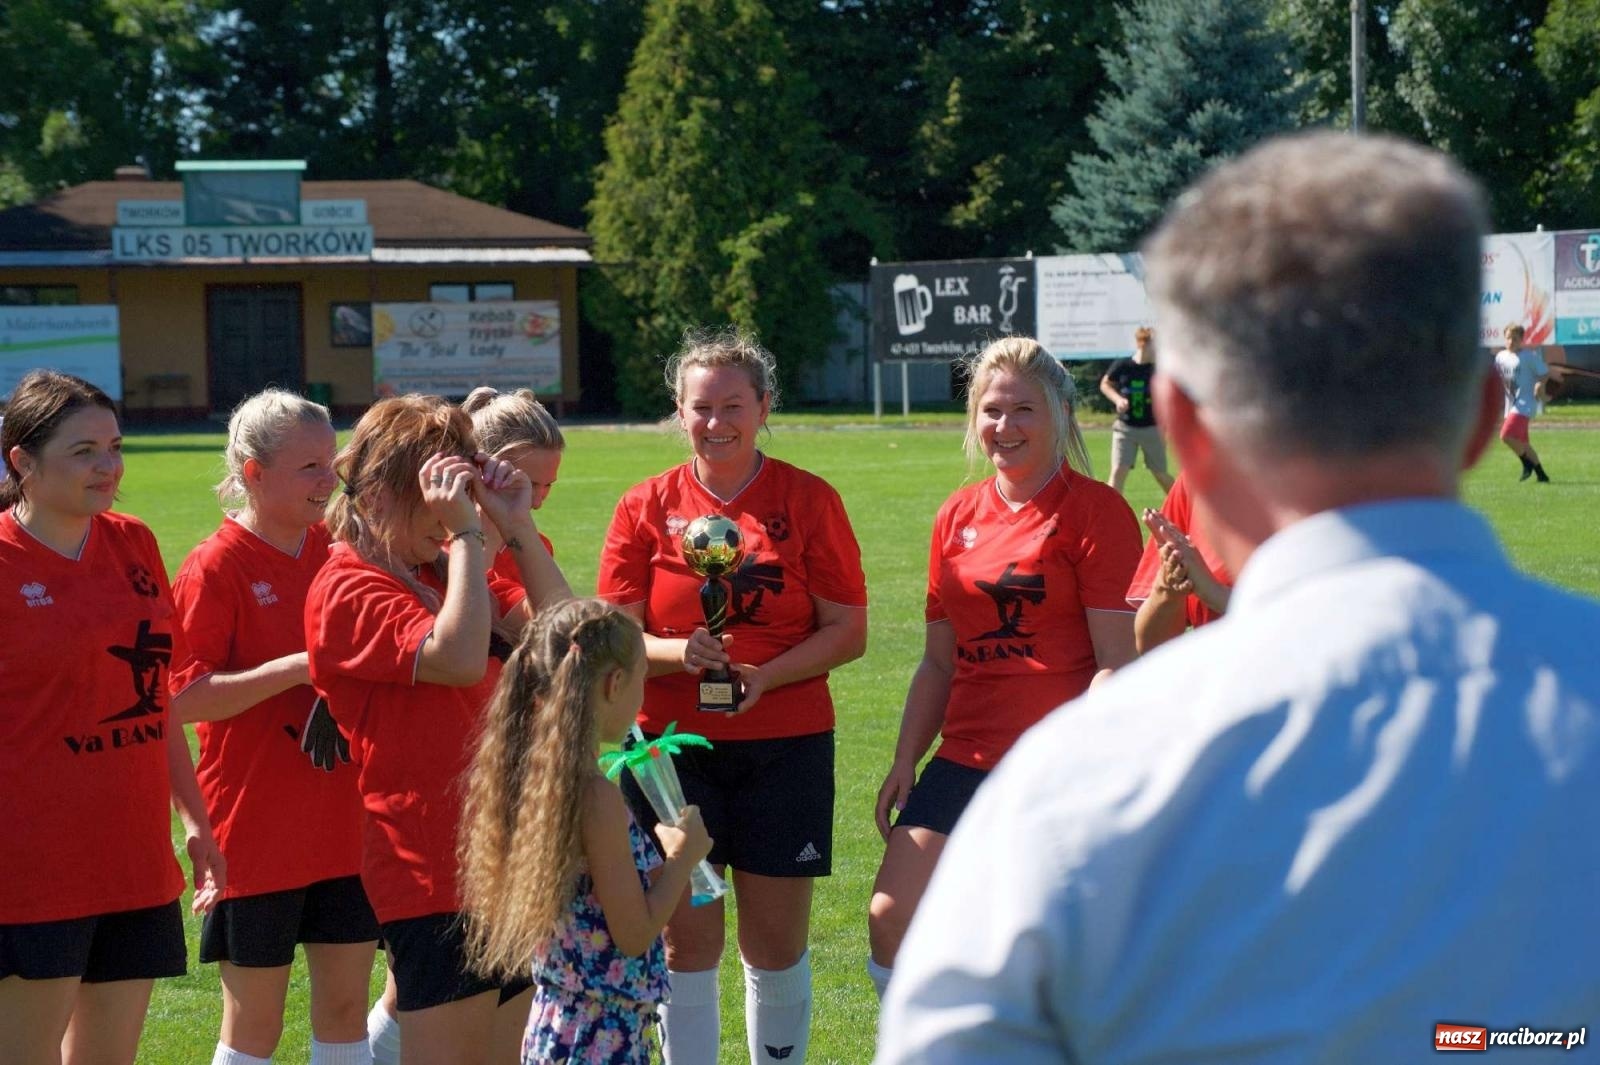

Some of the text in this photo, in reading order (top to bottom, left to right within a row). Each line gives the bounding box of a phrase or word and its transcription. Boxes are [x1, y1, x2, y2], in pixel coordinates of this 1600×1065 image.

[119, 226, 367, 256] LKS 05 TWORKÓW
[935, 276, 969, 297] LEX
[954, 304, 992, 325] BAR
[63, 733, 104, 754] Va
[795, 853, 821, 862] adidas
